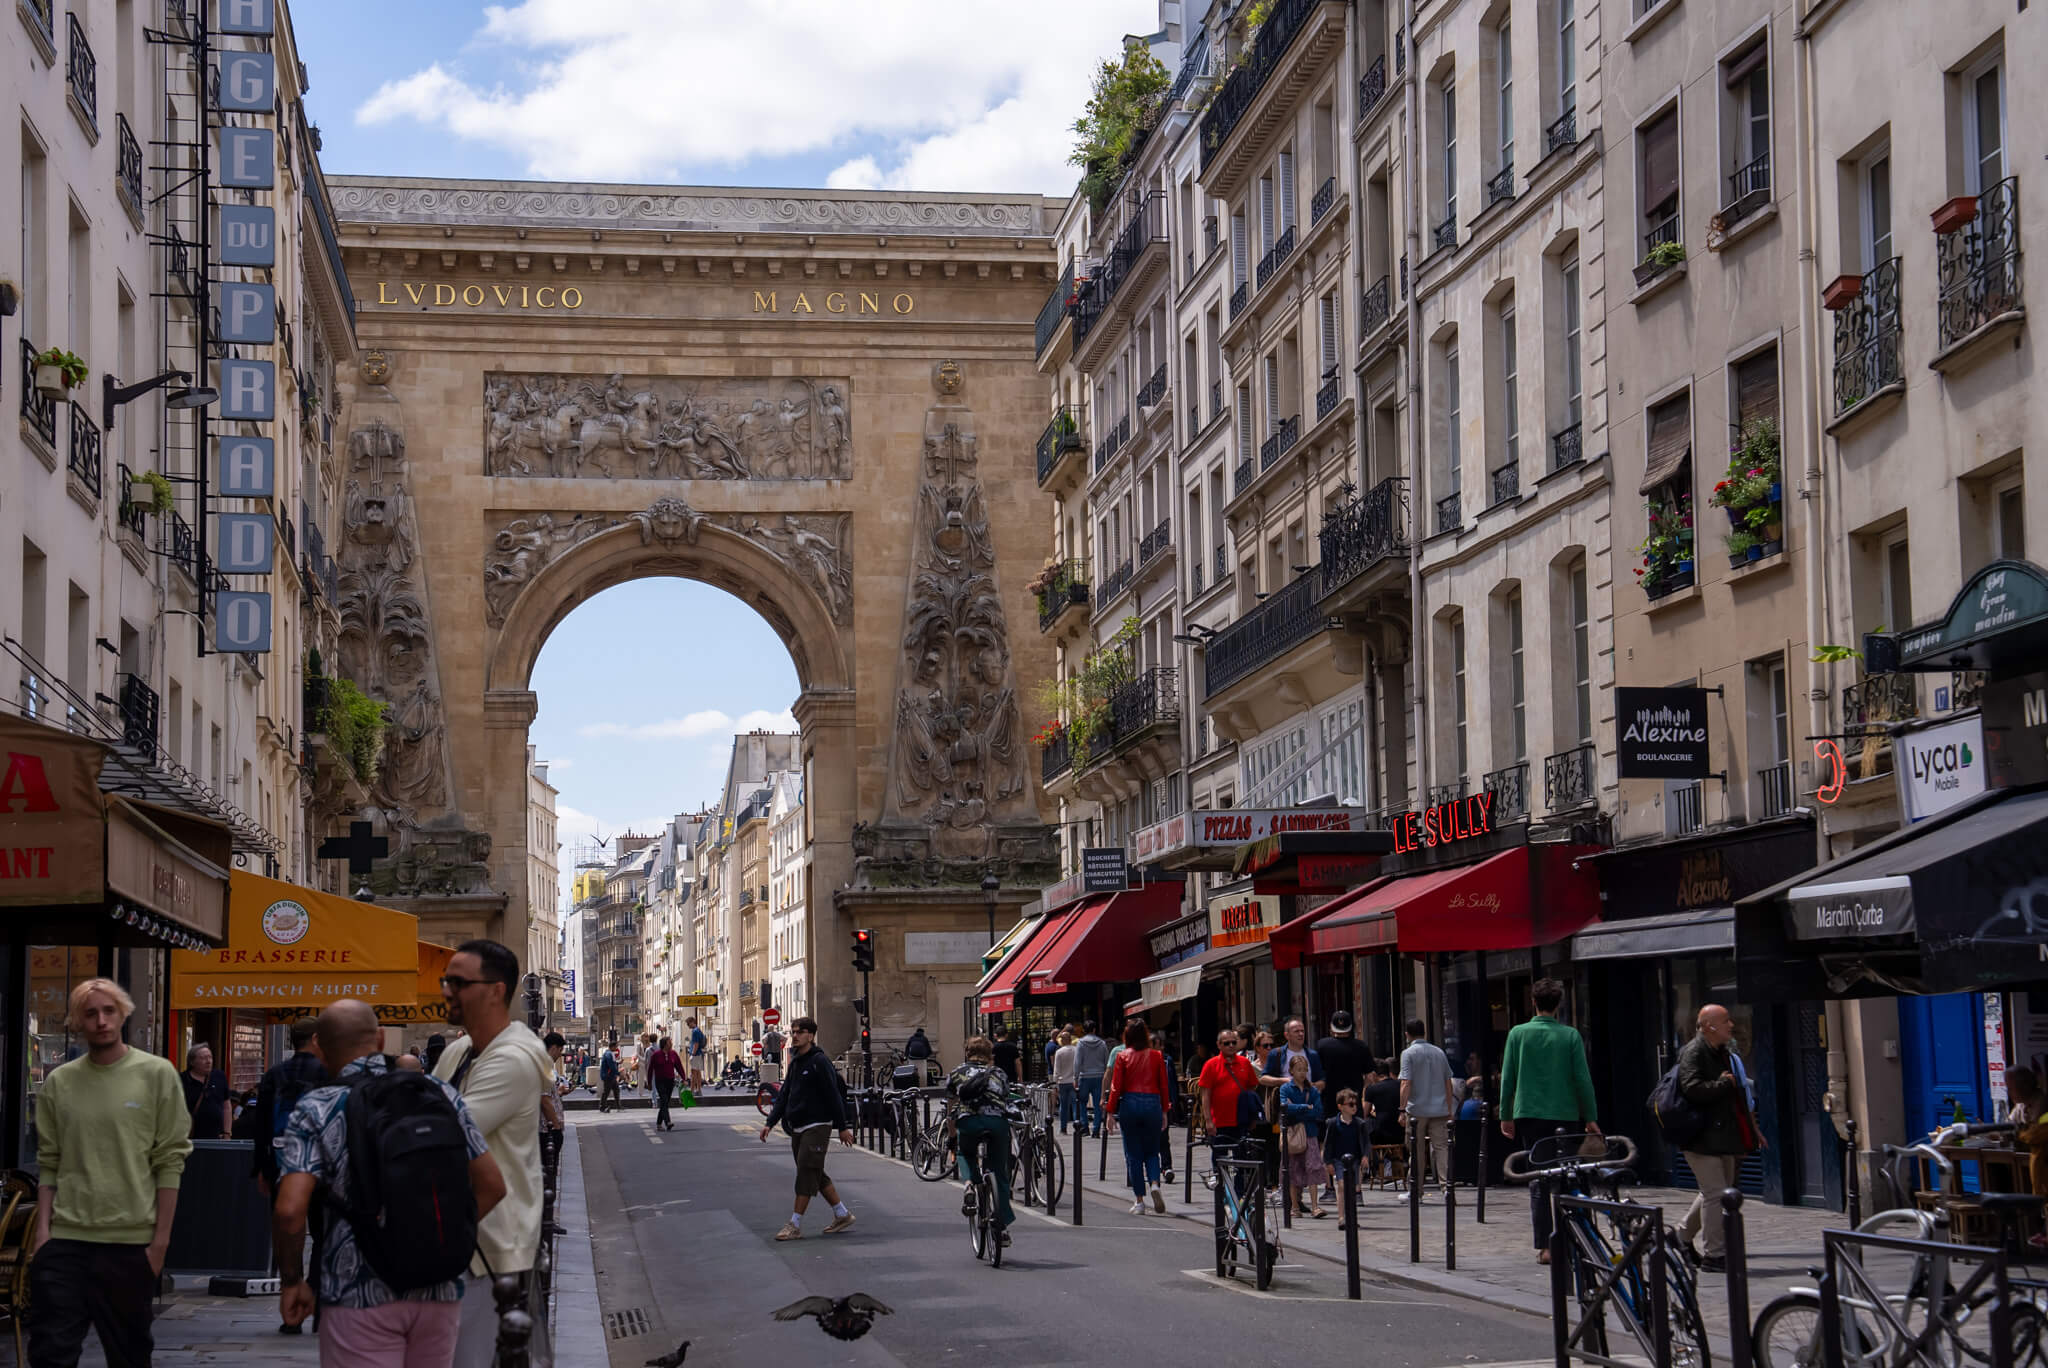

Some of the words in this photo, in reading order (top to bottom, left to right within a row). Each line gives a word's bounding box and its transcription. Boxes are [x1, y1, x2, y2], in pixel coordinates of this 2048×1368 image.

[227, 221, 268, 249] DU
[377, 282, 583, 308] LVDOVICO
[753, 291, 914, 314] MAGNO
[226, 289, 265, 645] PRADO
[1623, 721, 1706, 742] Alexine
[1636, 753, 1694, 761] BOULANGERIE
[1912, 743, 1958, 784] Lyca
[1934, 776, 1960, 792] Mobile
[1203, 815, 1253, 841] PIZZAS
[1393, 812, 1418, 854] LE
[1425, 791, 1491, 848] SULLY
[1085, 870, 1125, 878] CHARCUTERIE
[1448, 893, 1465, 908] Le
[1467, 893, 1501, 914] Sully
[1816, 904, 1854, 928] Mardin
[1855, 903, 1884, 932] Çorba
[218, 949, 353, 964] BRASSERIE
[193, 984, 304, 998] SANDWICH
[311, 983, 380, 997] KURDE
